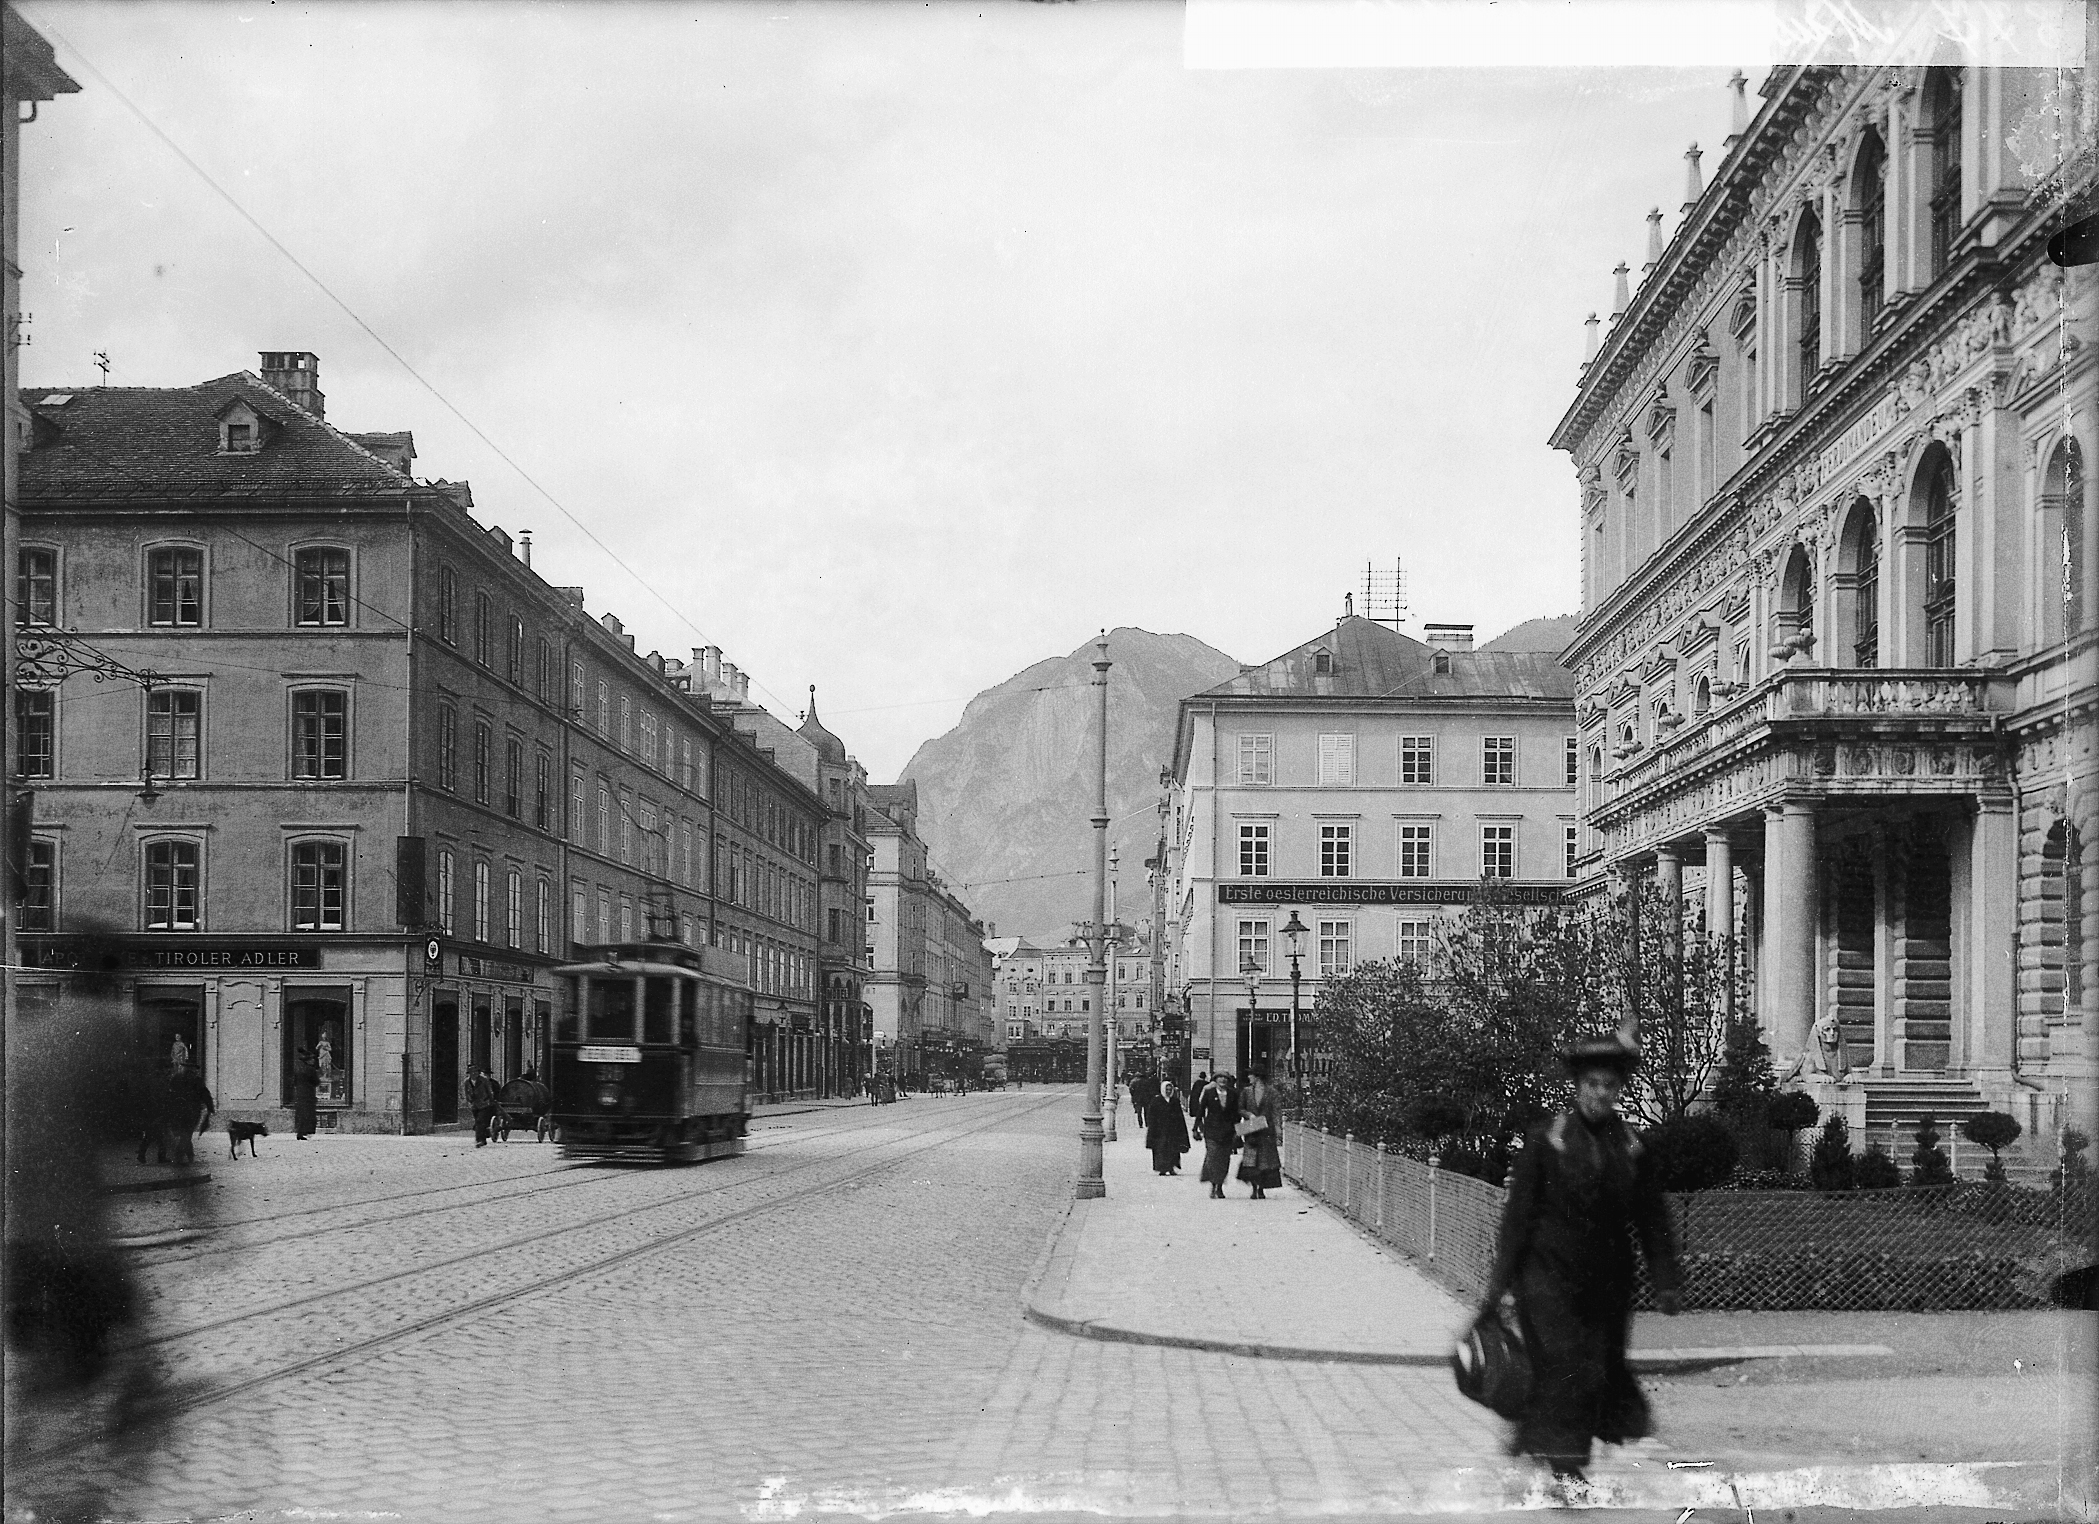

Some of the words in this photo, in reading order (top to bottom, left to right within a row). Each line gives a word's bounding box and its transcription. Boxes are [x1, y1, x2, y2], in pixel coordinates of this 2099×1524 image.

[1225, 885, 1262, 901] Erste
[1266, 885, 1386, 901] oesterreichische
[155, 952, 231, 965] TIROLER
[241, 952, 299, 965] ADLER
